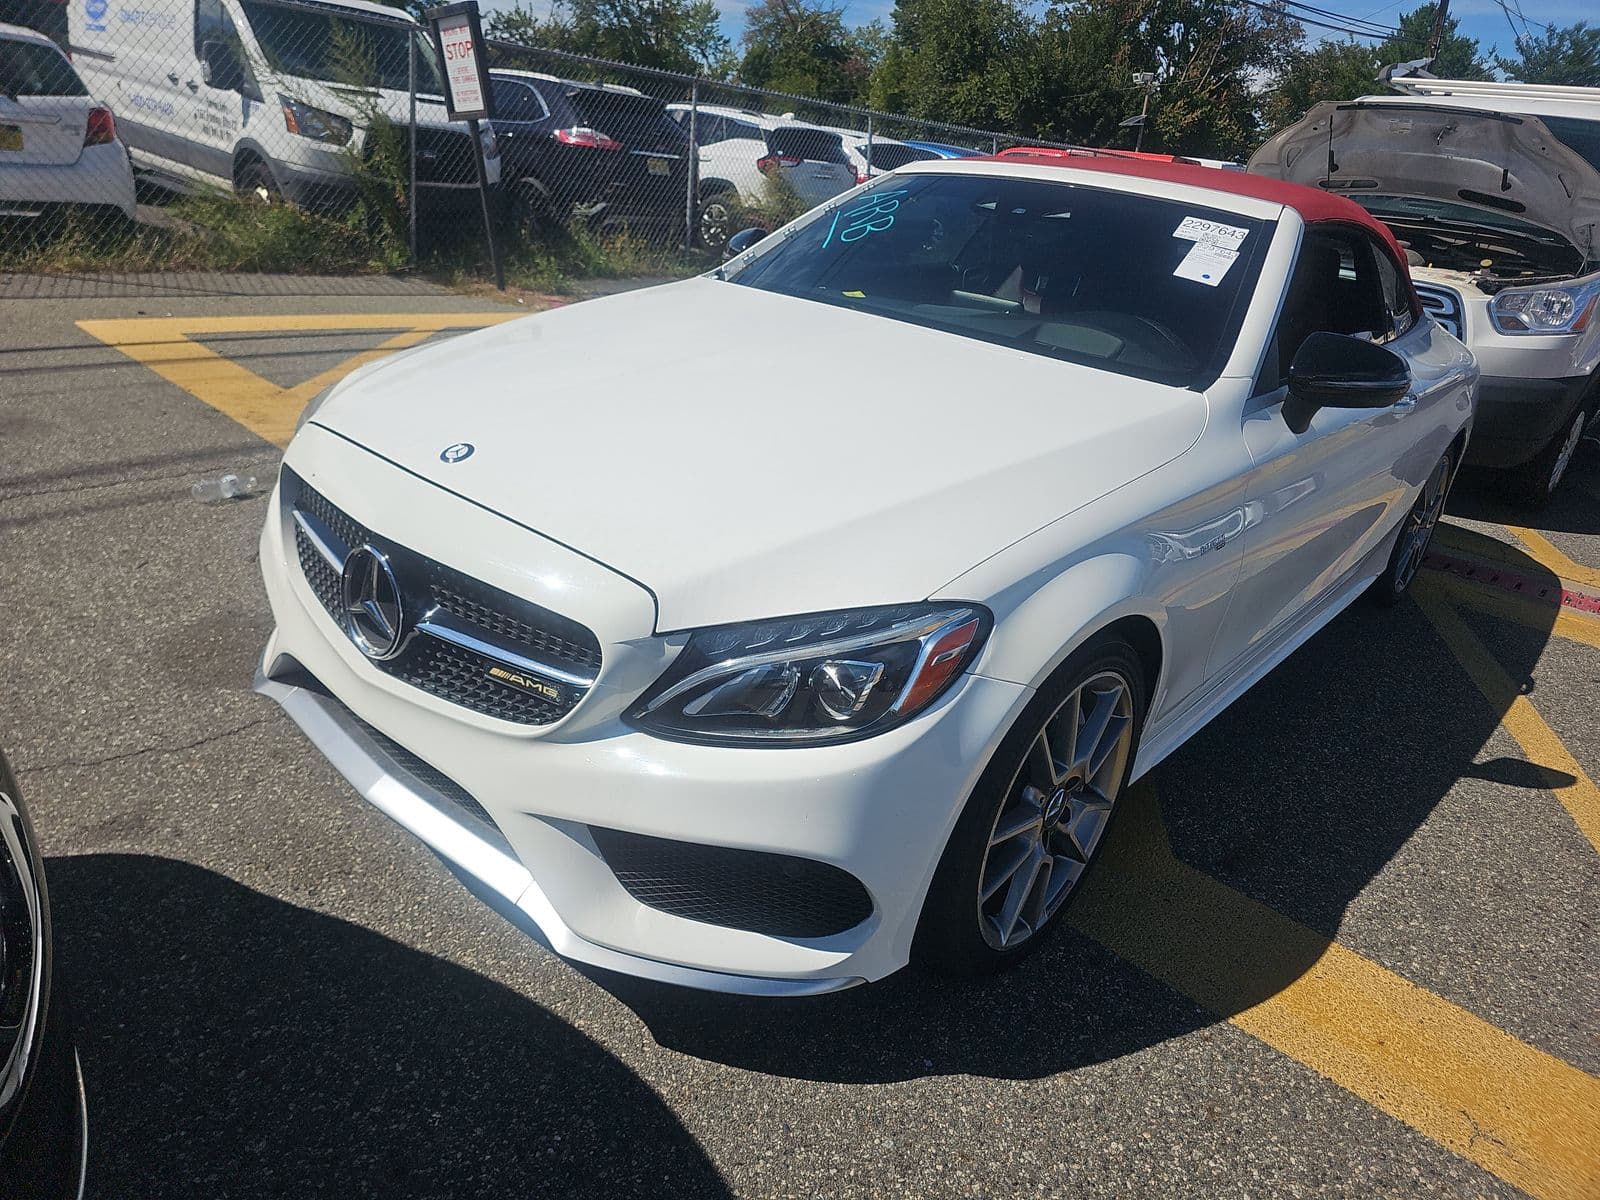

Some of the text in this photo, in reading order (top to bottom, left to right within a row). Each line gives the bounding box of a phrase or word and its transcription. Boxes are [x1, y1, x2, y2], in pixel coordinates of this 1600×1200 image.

[445, 41, 473, 60] STOP
[1182, 219, 1246, 240] 2297643
[509, 675, 558, 698] AMG
